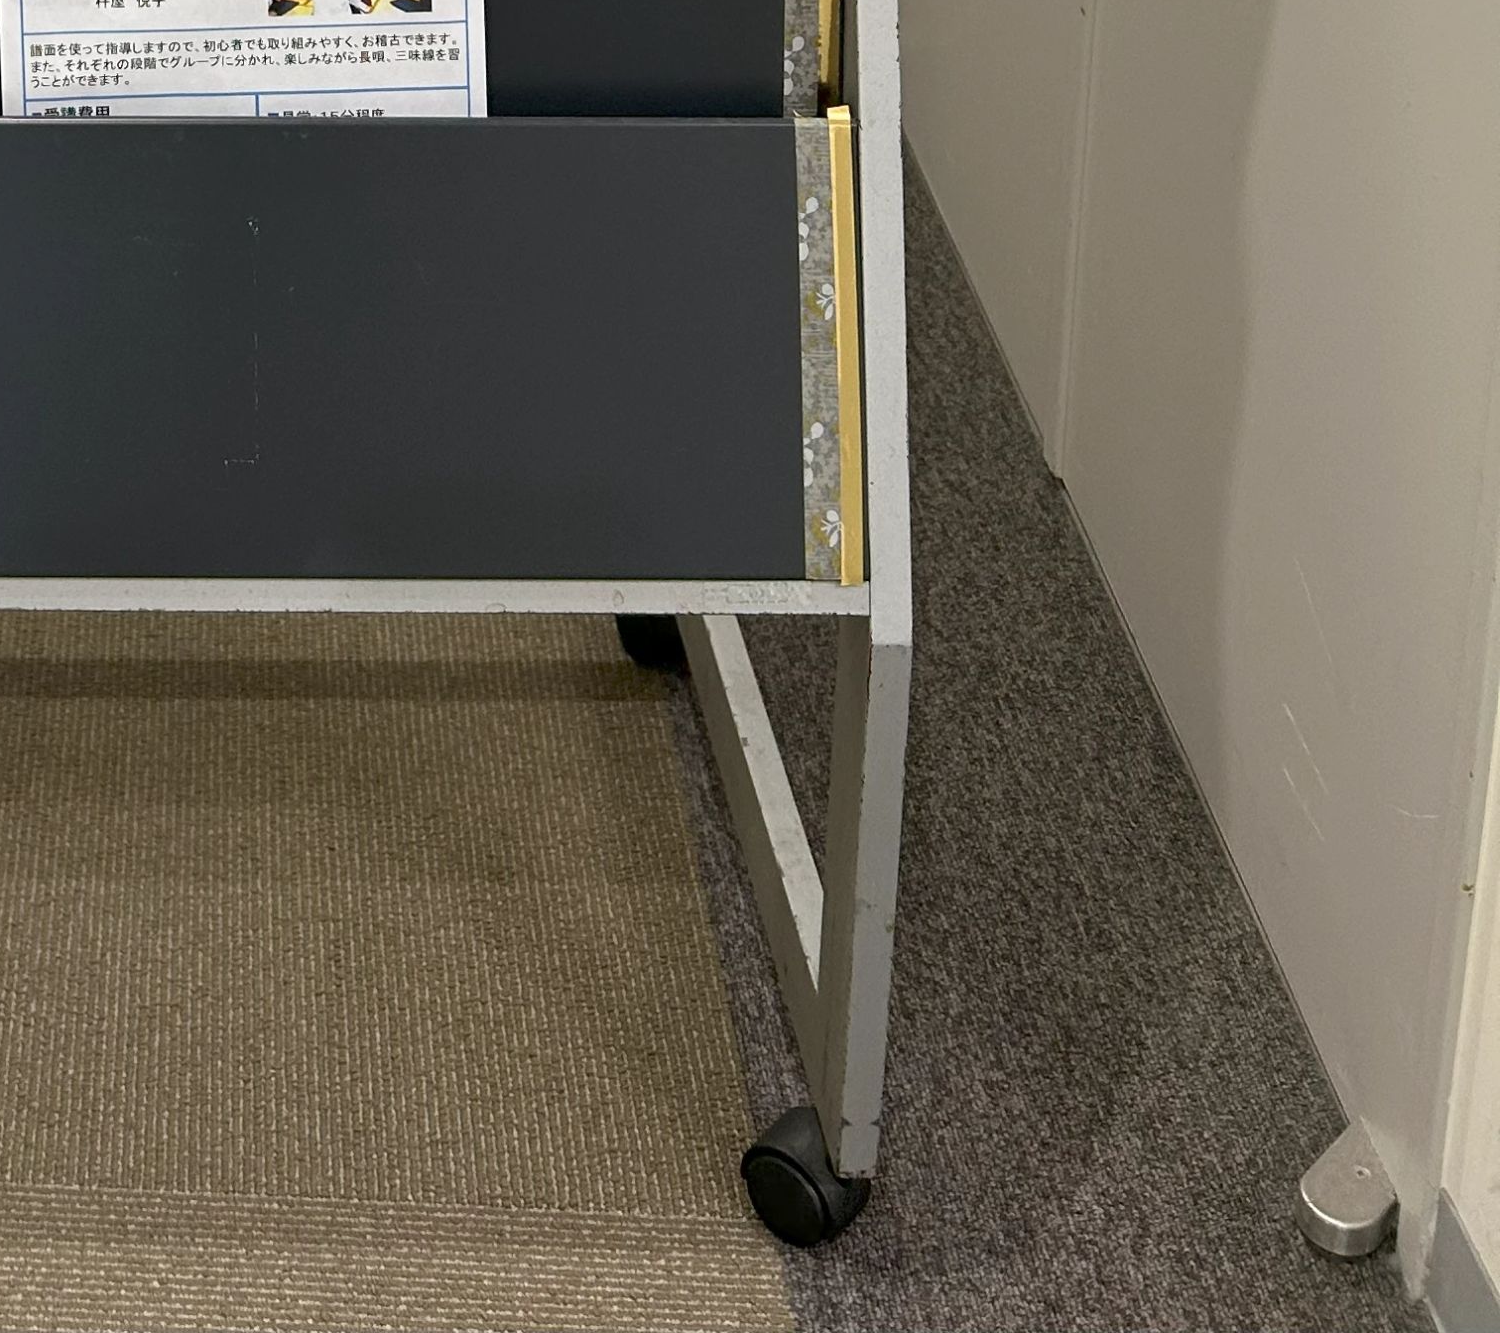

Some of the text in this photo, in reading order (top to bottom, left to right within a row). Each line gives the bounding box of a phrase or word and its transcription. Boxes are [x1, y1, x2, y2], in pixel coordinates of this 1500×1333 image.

[31, 73, 131, 90] うことができます。
